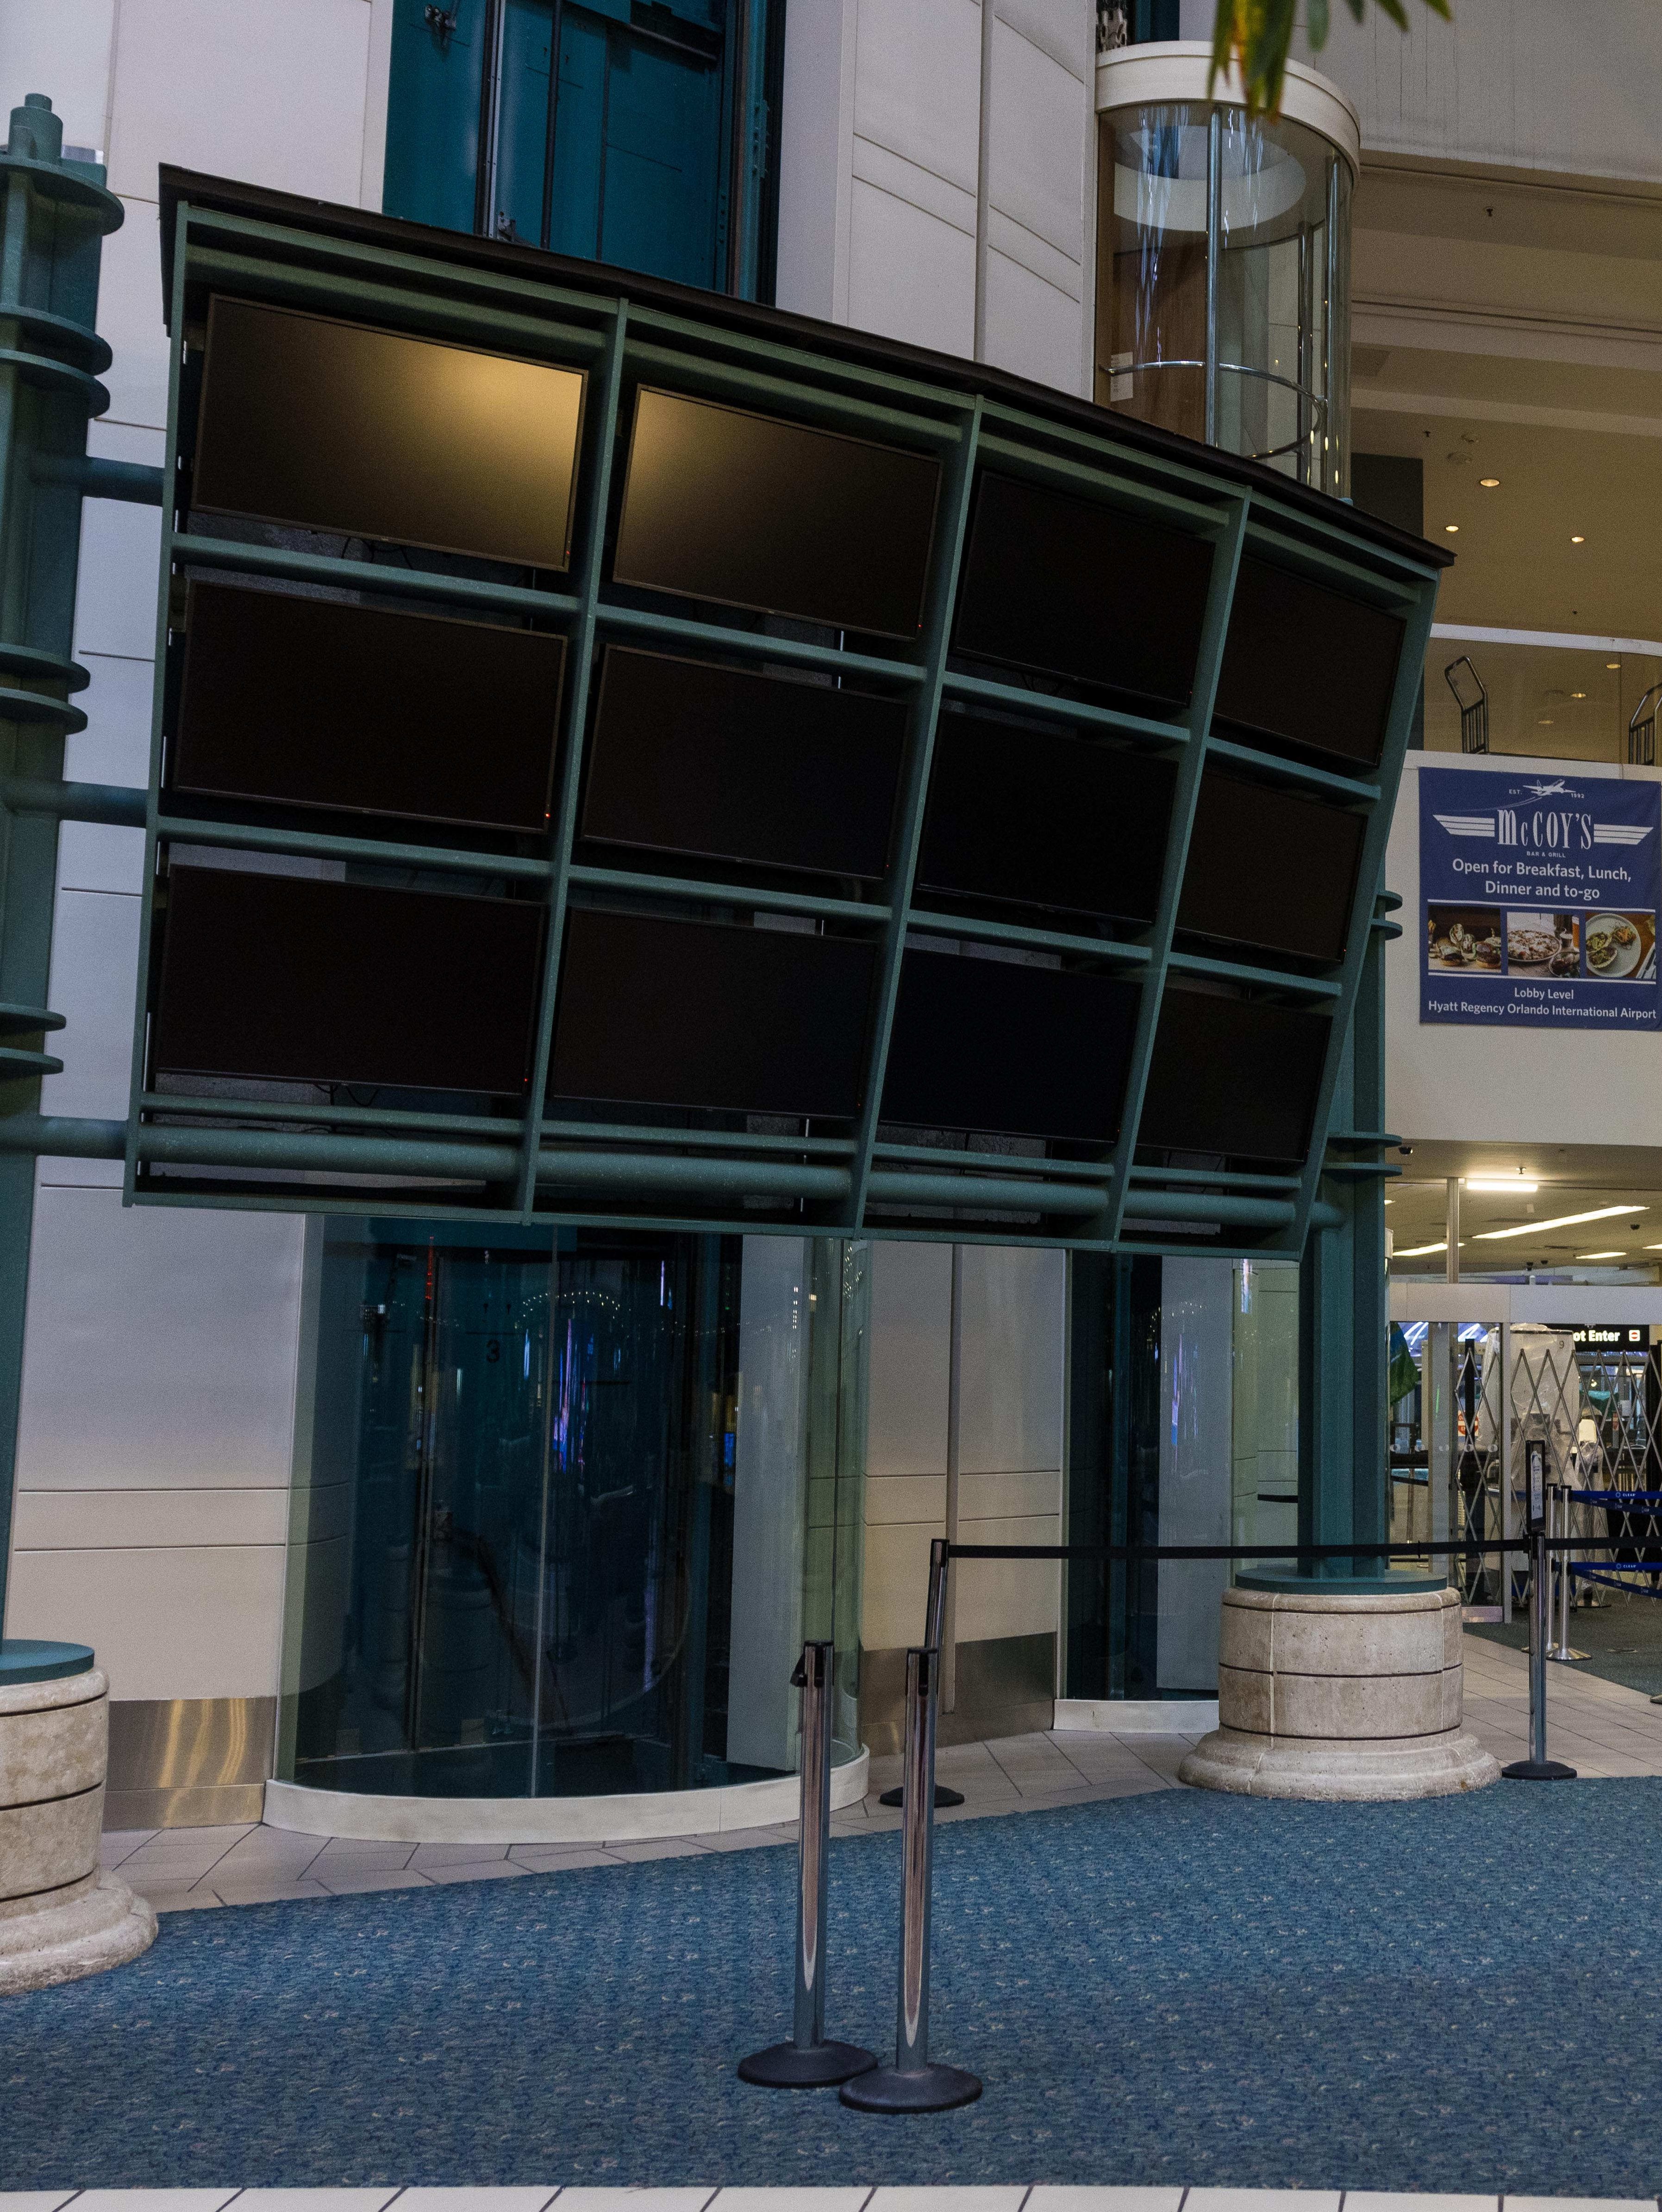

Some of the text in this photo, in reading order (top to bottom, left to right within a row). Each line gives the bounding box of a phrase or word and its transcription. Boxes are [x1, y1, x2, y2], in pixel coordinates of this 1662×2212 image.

[1452, 858, 1631, 882] Open for Breakfast, Lunch,
[1485, 880, 1600, 901] Dinner and to-go
[1514, 987, 1574, 1000] Lobby Level
[1428, 1000, 1656, 1020] Hyatt Regency Orlando International Airport
[1573, 1330, 1620, 1342] ot Enter
[487, 1339, 500, 1362] 3
